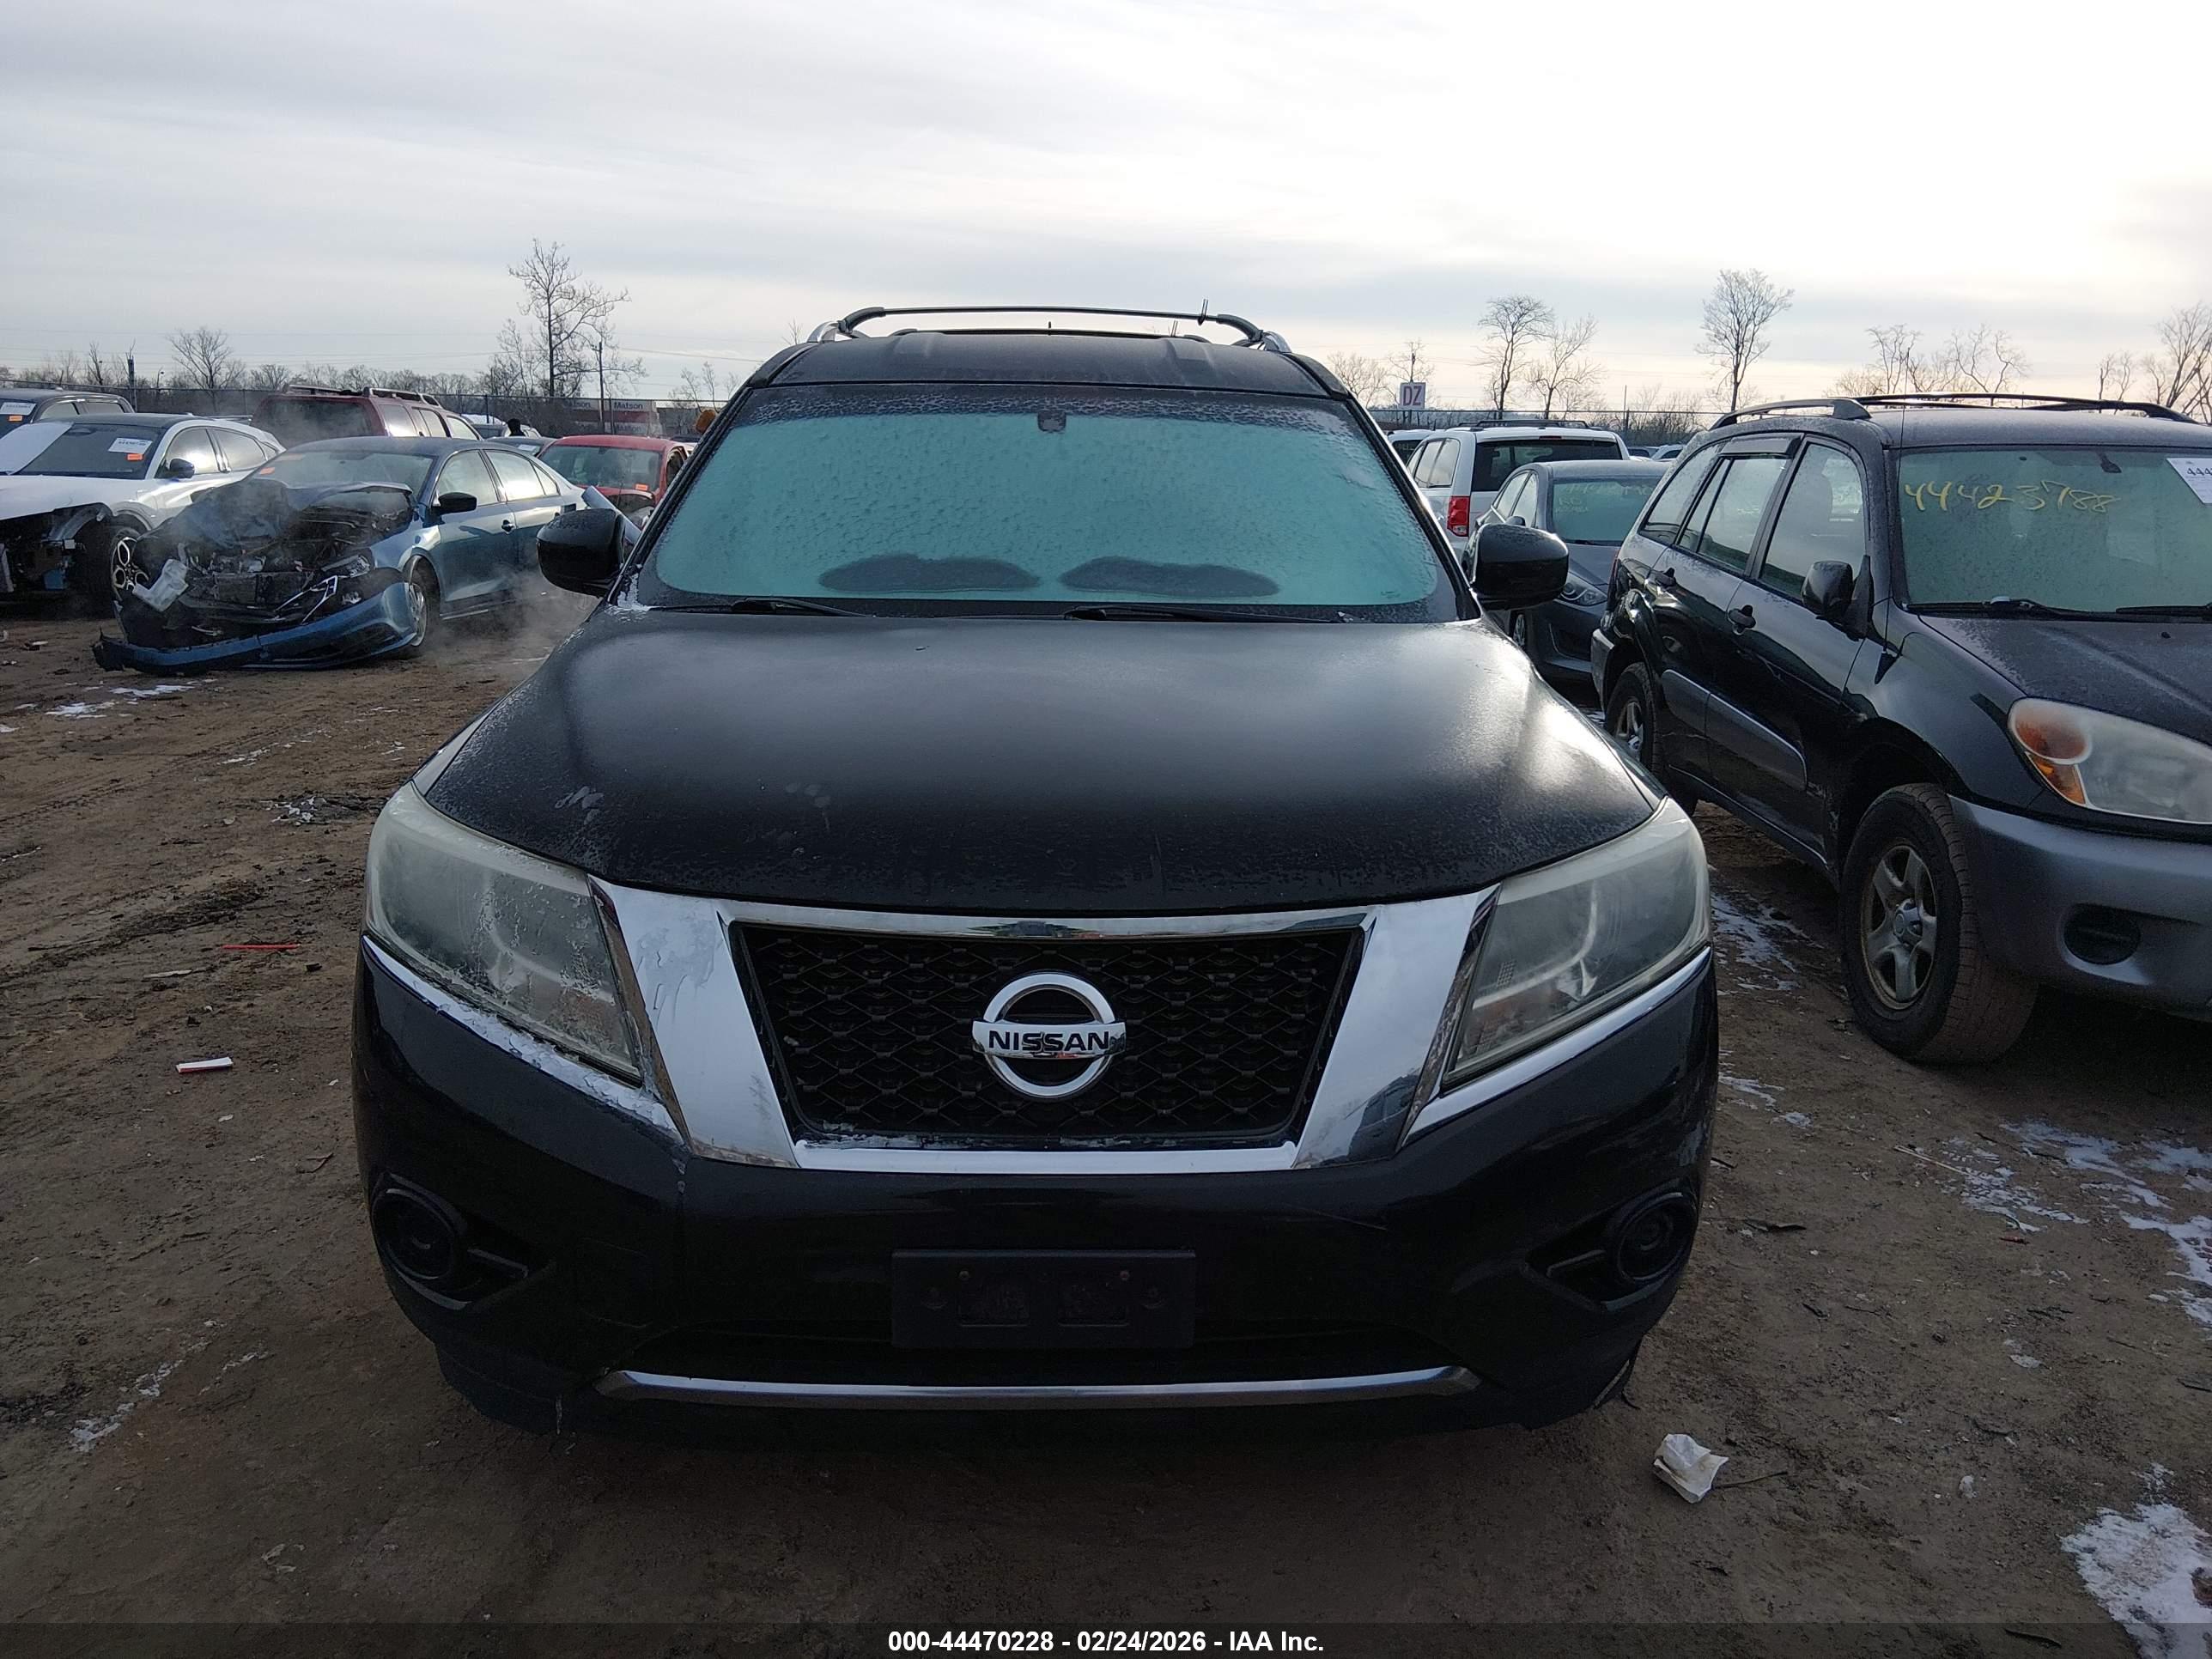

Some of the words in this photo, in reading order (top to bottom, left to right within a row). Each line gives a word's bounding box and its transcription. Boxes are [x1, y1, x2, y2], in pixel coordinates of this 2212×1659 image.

[1403, 386, 1423, 406] DZ
[1904, 480, 2122, 514] 44423788
[988, 1030, 1109, 1052] NISSAN
